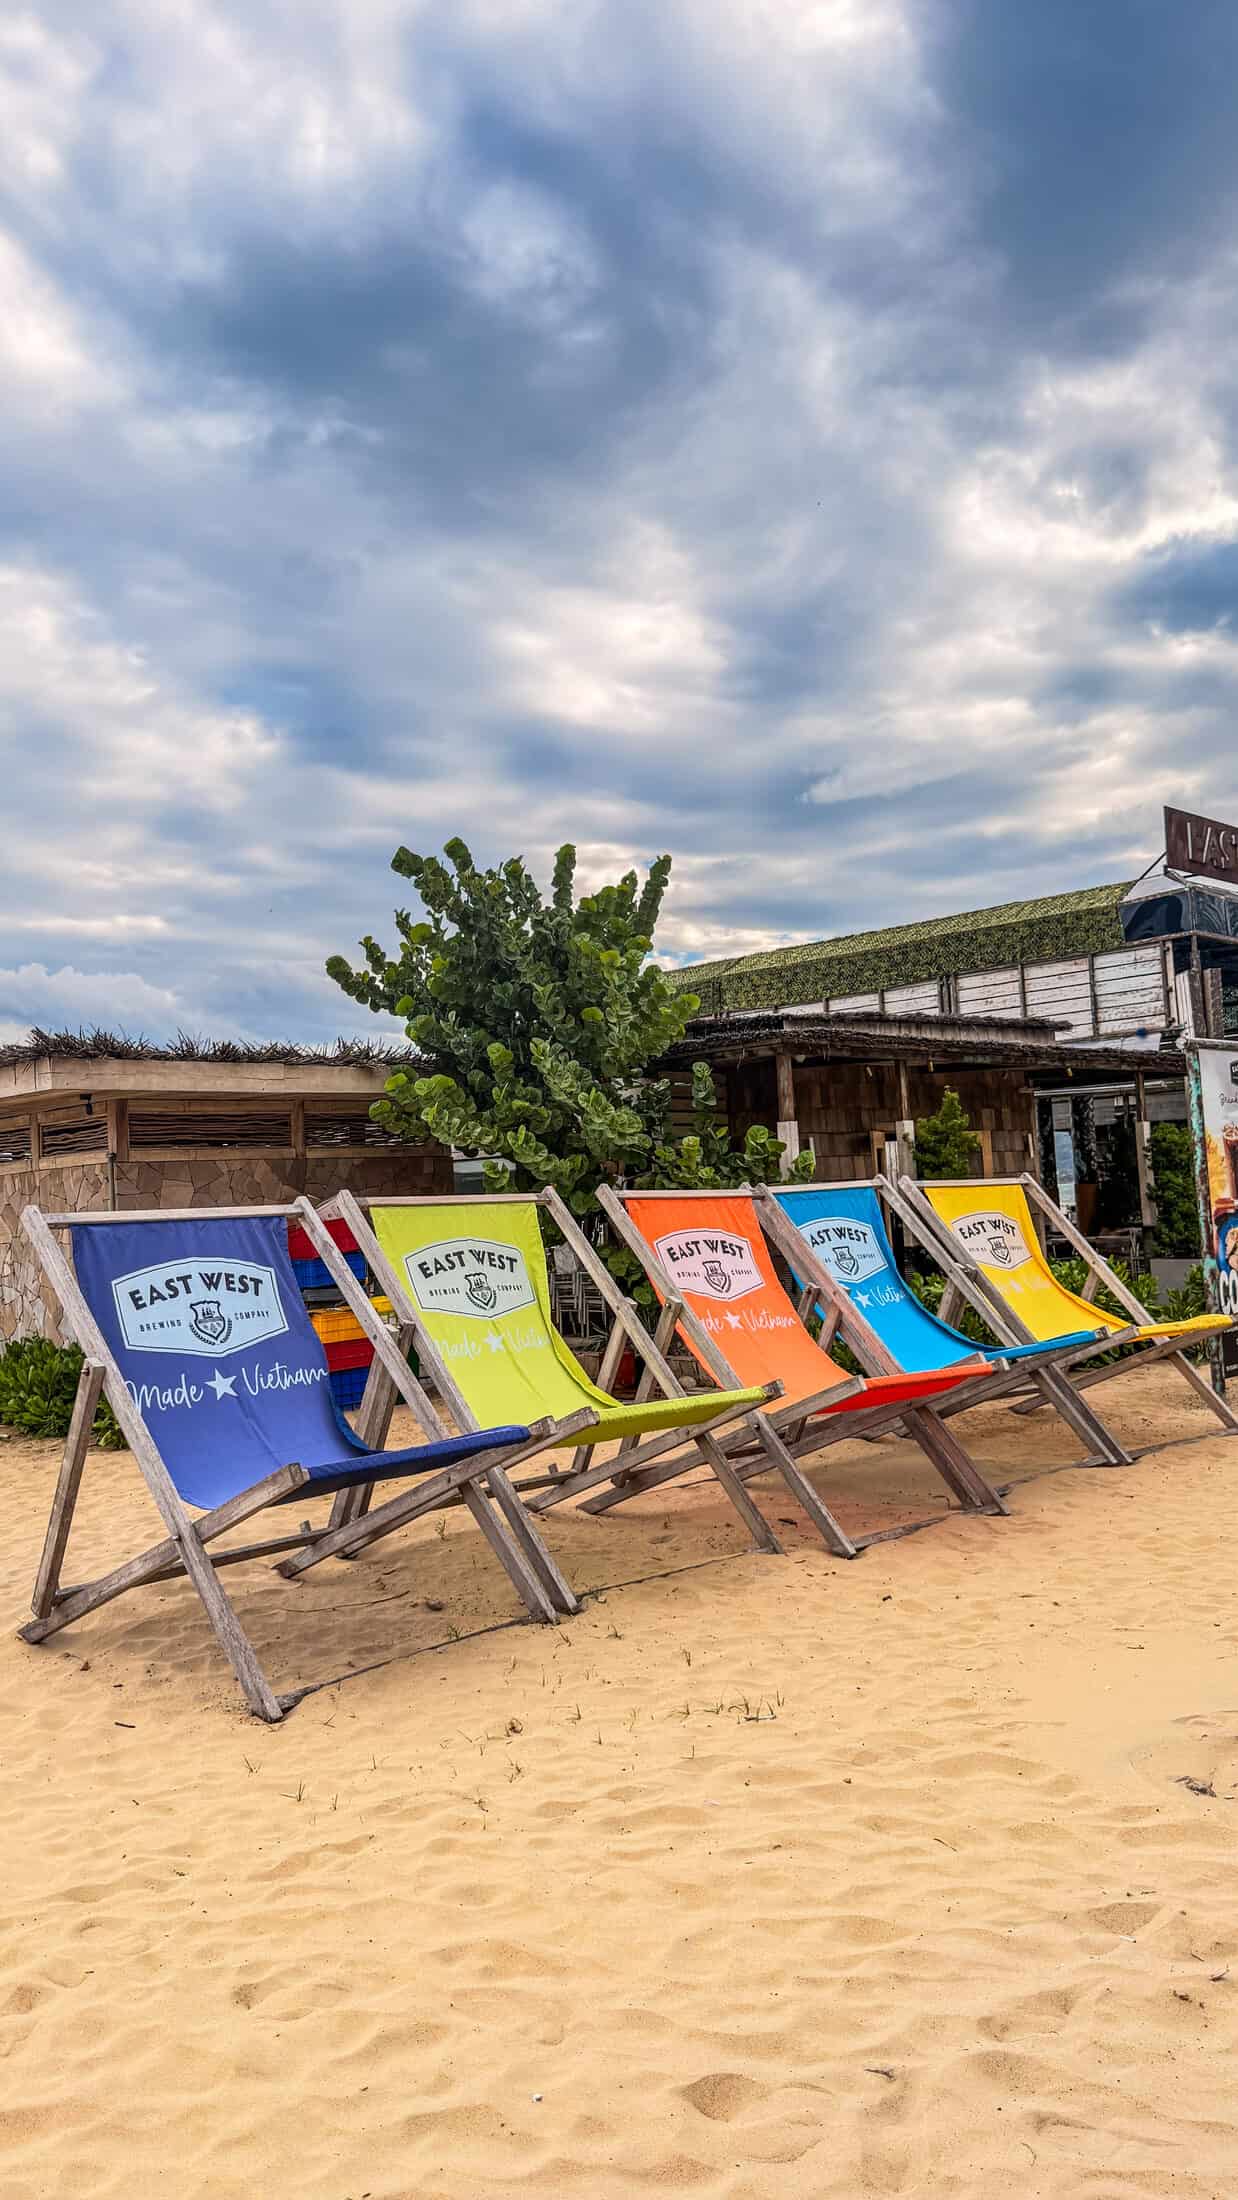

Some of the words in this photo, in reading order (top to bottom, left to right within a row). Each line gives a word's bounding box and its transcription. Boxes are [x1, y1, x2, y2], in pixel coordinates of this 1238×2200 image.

[810, 1228, 832, 1248] AST
[832, 1227, 868, 1244] WEST
[959, 1221, 987, 1240] EAST
[988, 1219, 1016, 1237] WEST
[667, 1241, 701, 1262] EAST
[703, 1239, 744, 1260] WEST
[418, 1250, 466, 1279] EAST
[469, 1248, 518, 1273] WEST
[128, 1275, 193, 1311] EAST
[199, 1271, 264, 1298] WEST
[139, 1319, 183, 1333] BREWING
[234, 1309, 271, 1322] COMPANY
[125, 1373, 204, 1414] Made
[241, 1362, 329, 1396] Vietnam
